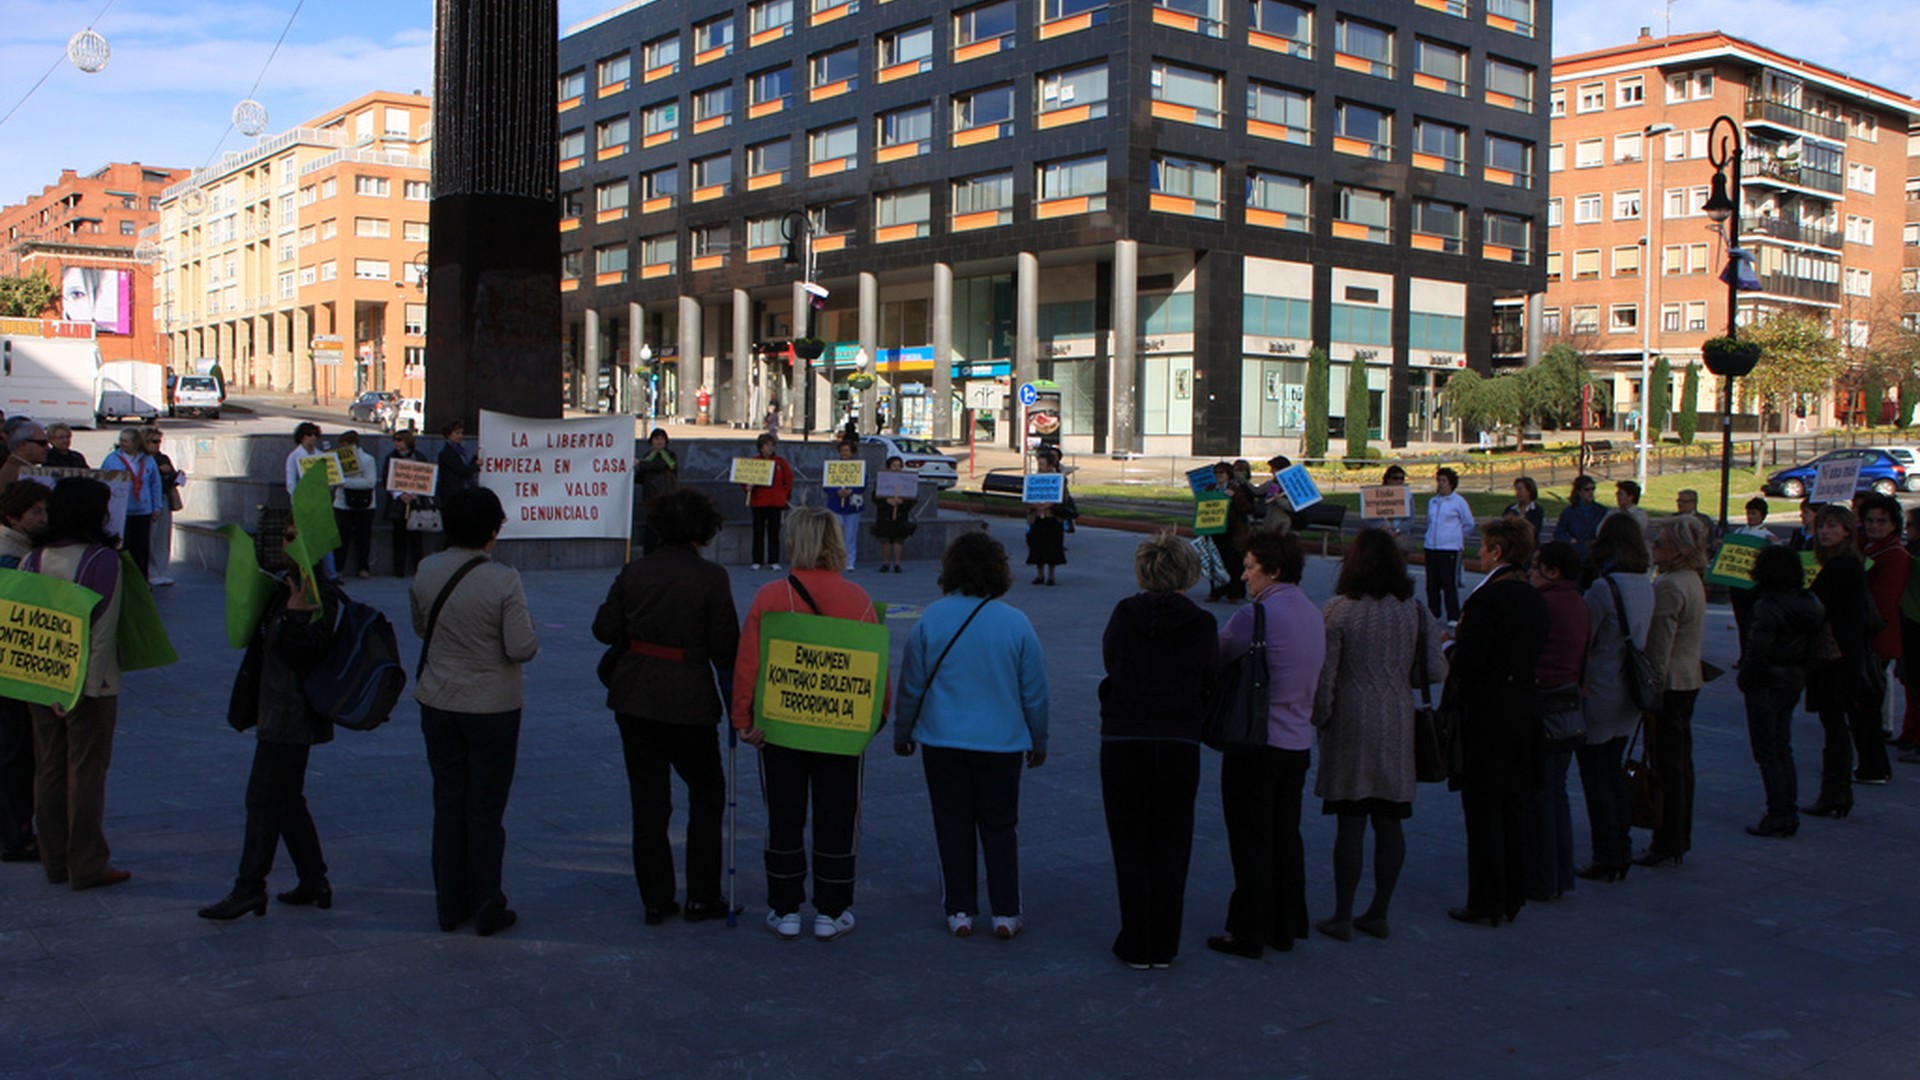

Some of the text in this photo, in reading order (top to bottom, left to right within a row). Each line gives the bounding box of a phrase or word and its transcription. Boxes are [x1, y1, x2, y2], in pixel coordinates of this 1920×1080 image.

[0, 320, 40, 335] DURNE
[59, 322, 91, 338] ALAIN
[512, 433, 614, 448] LA LIBERTAD
[486, 457, 626, 474] EMPIEZA EN CASA
[515, 482, 608, 497] TEN VALOR
[521, 506, 599, 521] DENUNCIALO
[10, 605, 72, 638] LA VIOLENCIA
[0, 626, 79, 662] ONTRA LA MUJER
[10, 650, 71, 680] TERRORISMO
[795, 645, 851, 671] EMAKUMEEN
[768, 664, 871, 698] KONTRAKO BIOLENTZIA
[842, 698, 854, 719] DA
